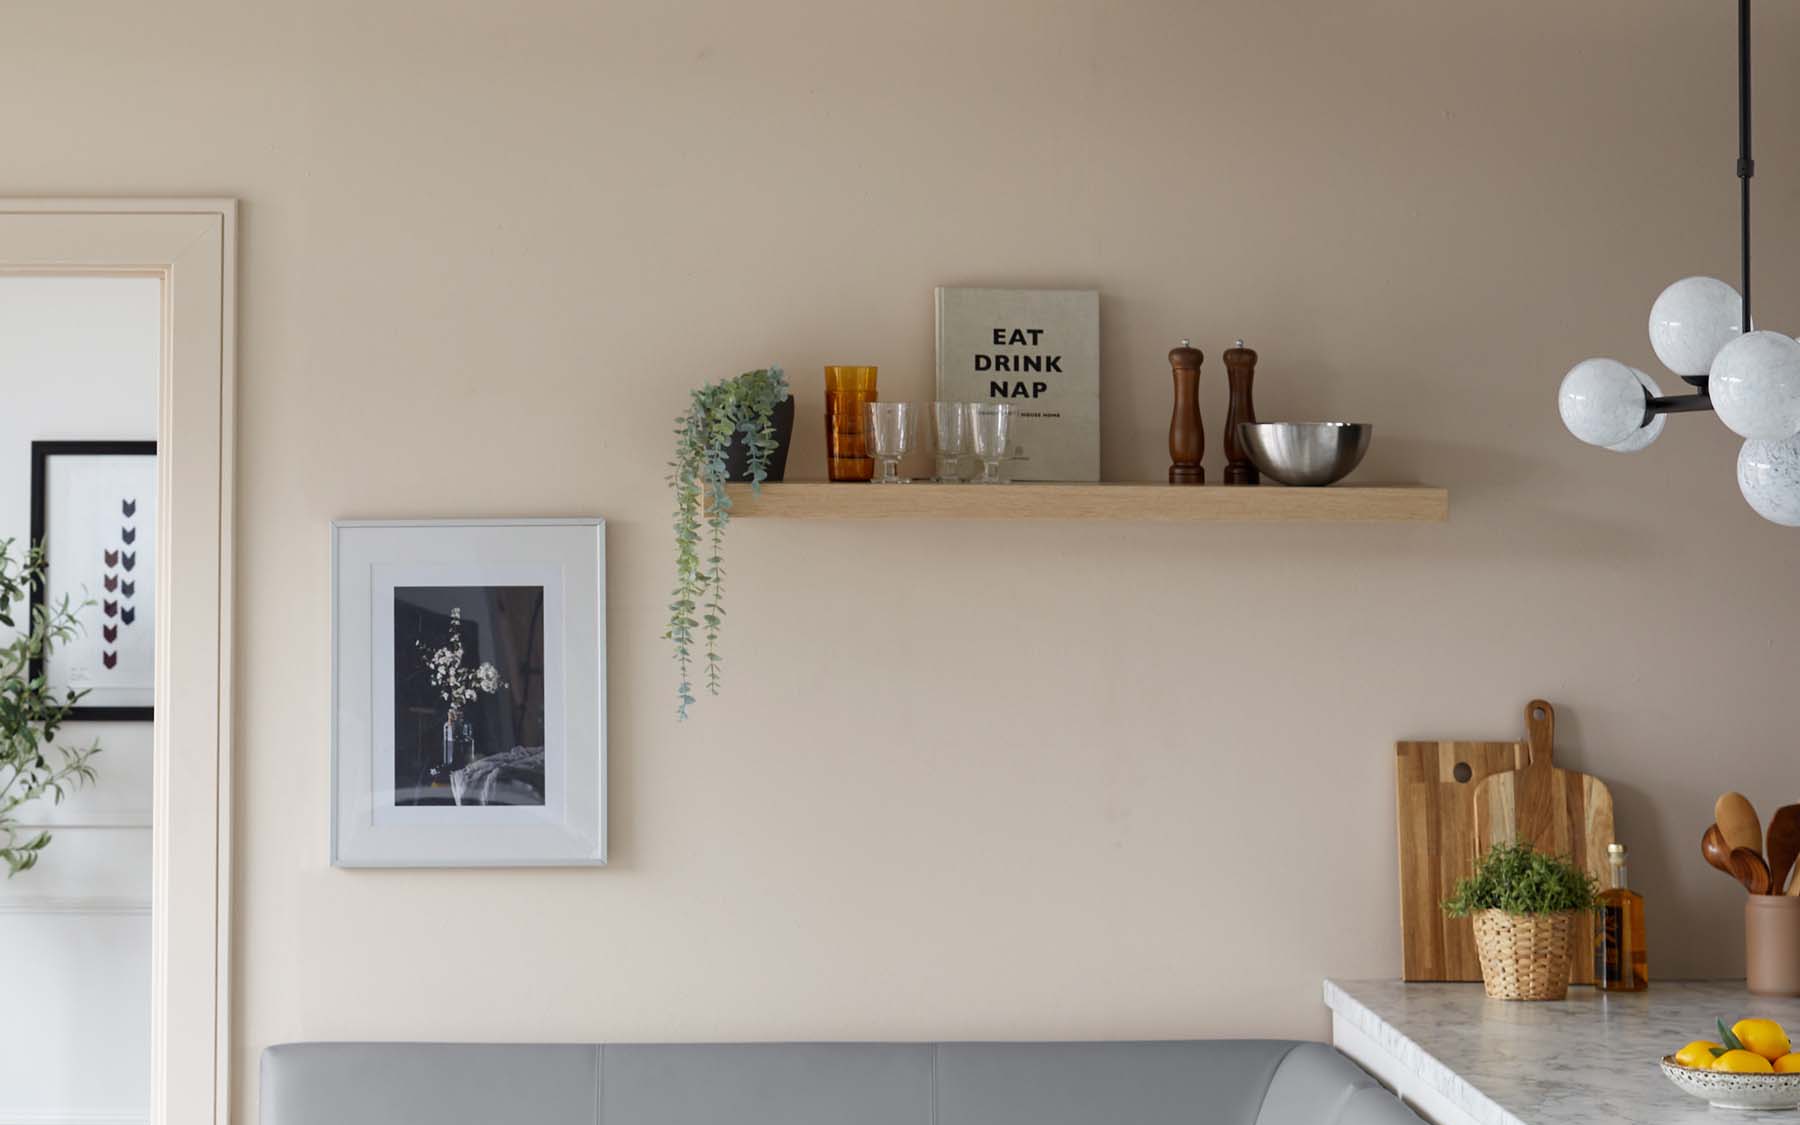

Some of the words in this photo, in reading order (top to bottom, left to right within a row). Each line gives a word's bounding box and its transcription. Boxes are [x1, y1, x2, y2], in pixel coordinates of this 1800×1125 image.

[993, 328, 1044, 346] EAT
[974, 354, 1063, 373] DRINK
[990, 381, 1048, 399] NAP
